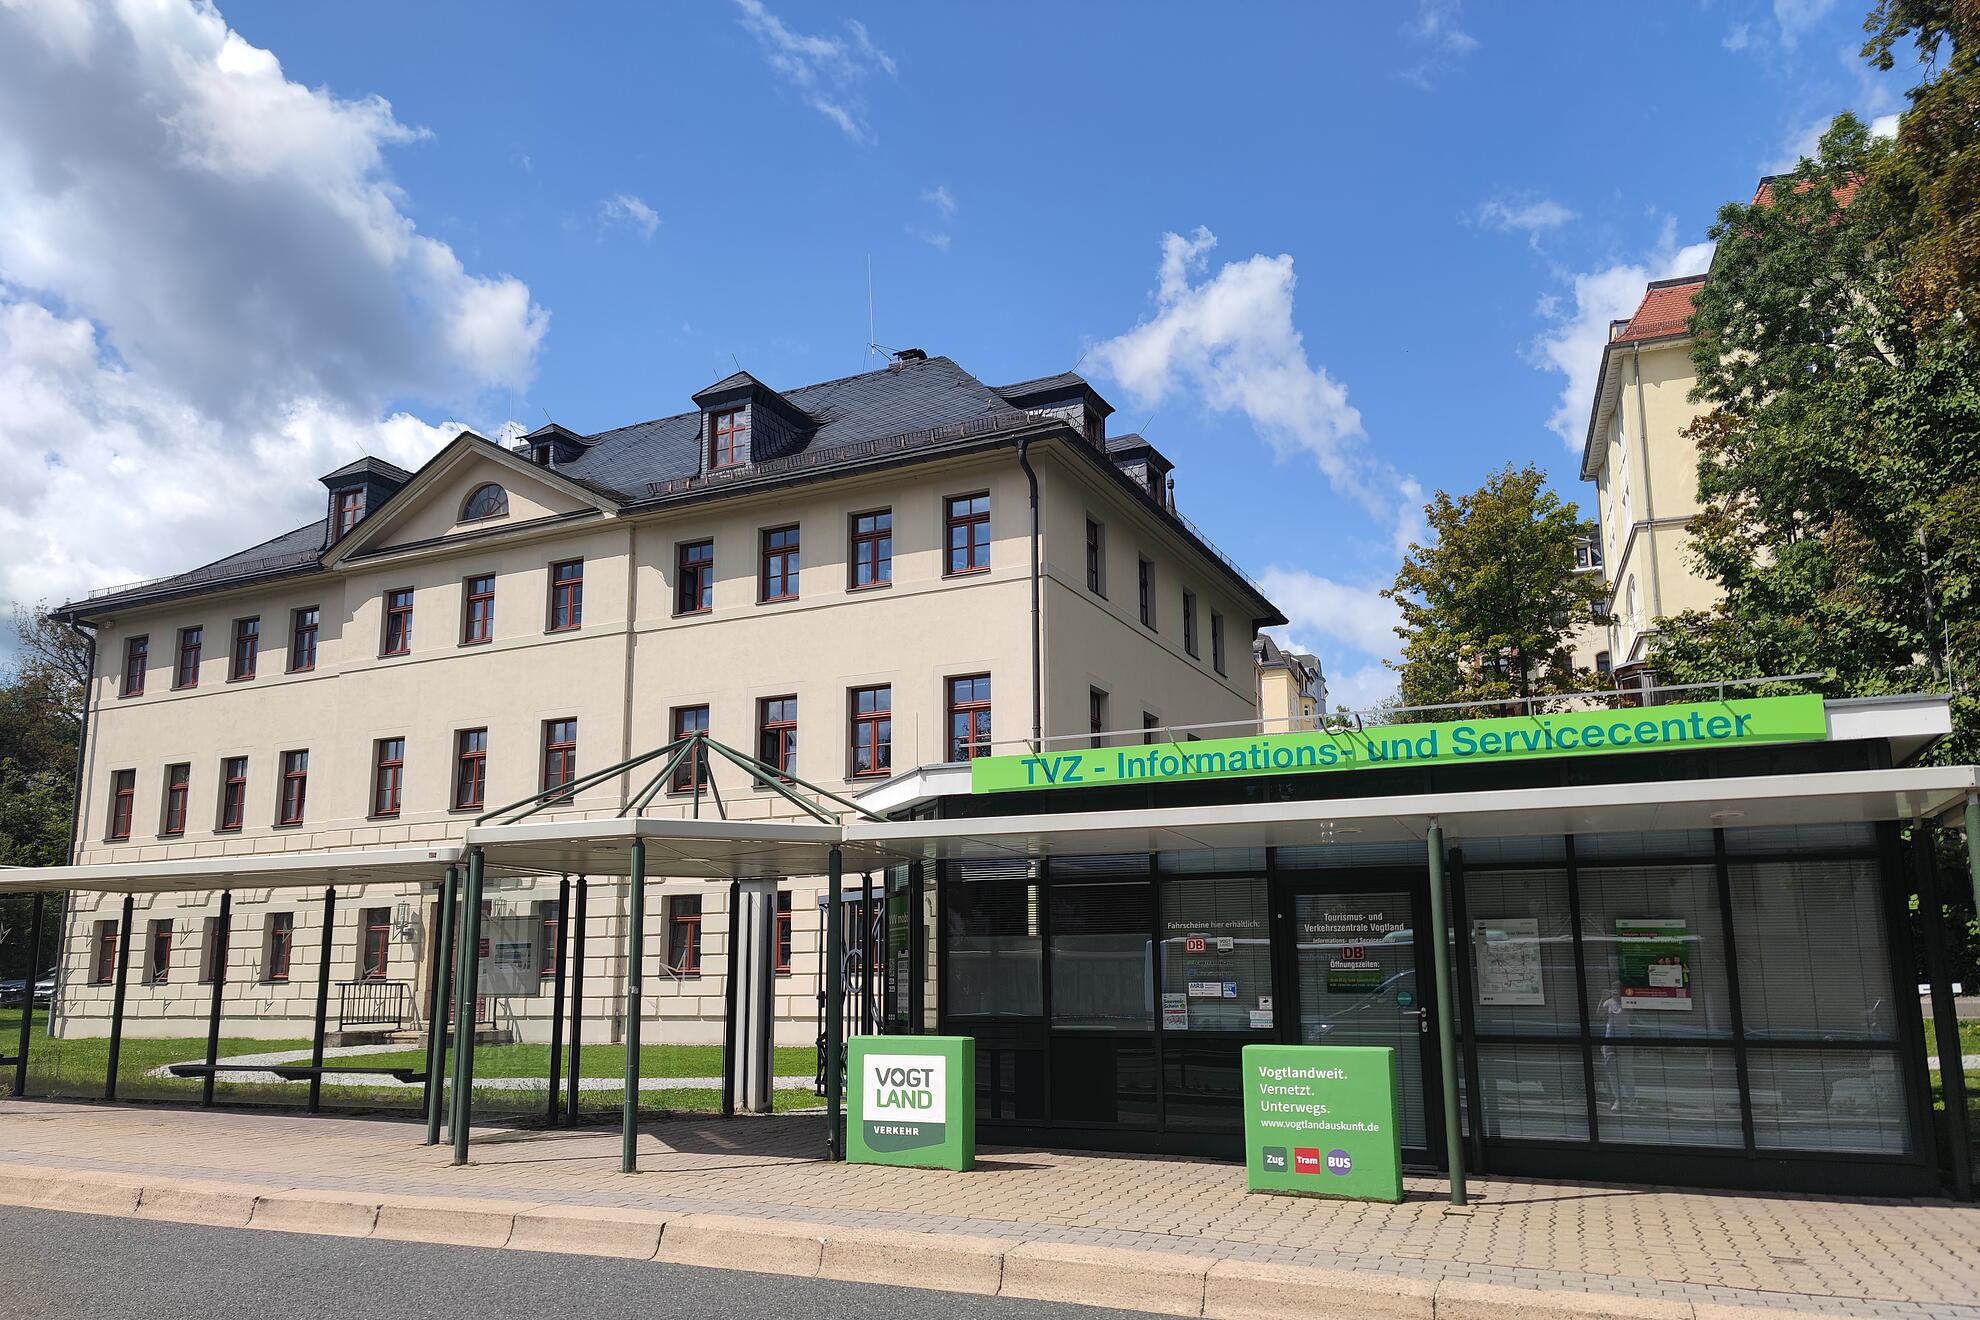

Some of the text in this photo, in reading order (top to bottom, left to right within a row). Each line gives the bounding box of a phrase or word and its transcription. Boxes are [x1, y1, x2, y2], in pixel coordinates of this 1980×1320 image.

[1021, 755, 1083, 785] TVZ
[1118, 741, 1353, 779] Informations-
[1367, 730, 1438, 762] und
[1452, 711, 1752, 756] Servicecenter
[1324, 912, 1383, 921] Tourismus- und
[1167, 920, 1260, 929] Fahrscheine hier erhältlich:
[1304, 923, 1404, 933] Verkehrszentrale Vogtland
[1188, 940, 1203, 950] DB
[1343, 947, 1363, 958] DB
[1330, 959, 1380, 969] Öffnungszeiten:
[875, 1067, 934, 1088] VOGT
[1259, 1066, 1348, 1080] Vogtlandweit.
[1259, 1084, 1315, 1096] Vernetzt.
[876, 1088, 933, 1109] LAND
[1261, 1101, 1331, 1116] Unterwegs.
[873, 1125, 920, 1136] VERKEHR
[1261, 1120, 1380, 1132] www.vogtlandauskunft.de
[1266, 1155, 1351, 1168] Zug Tram BUS
